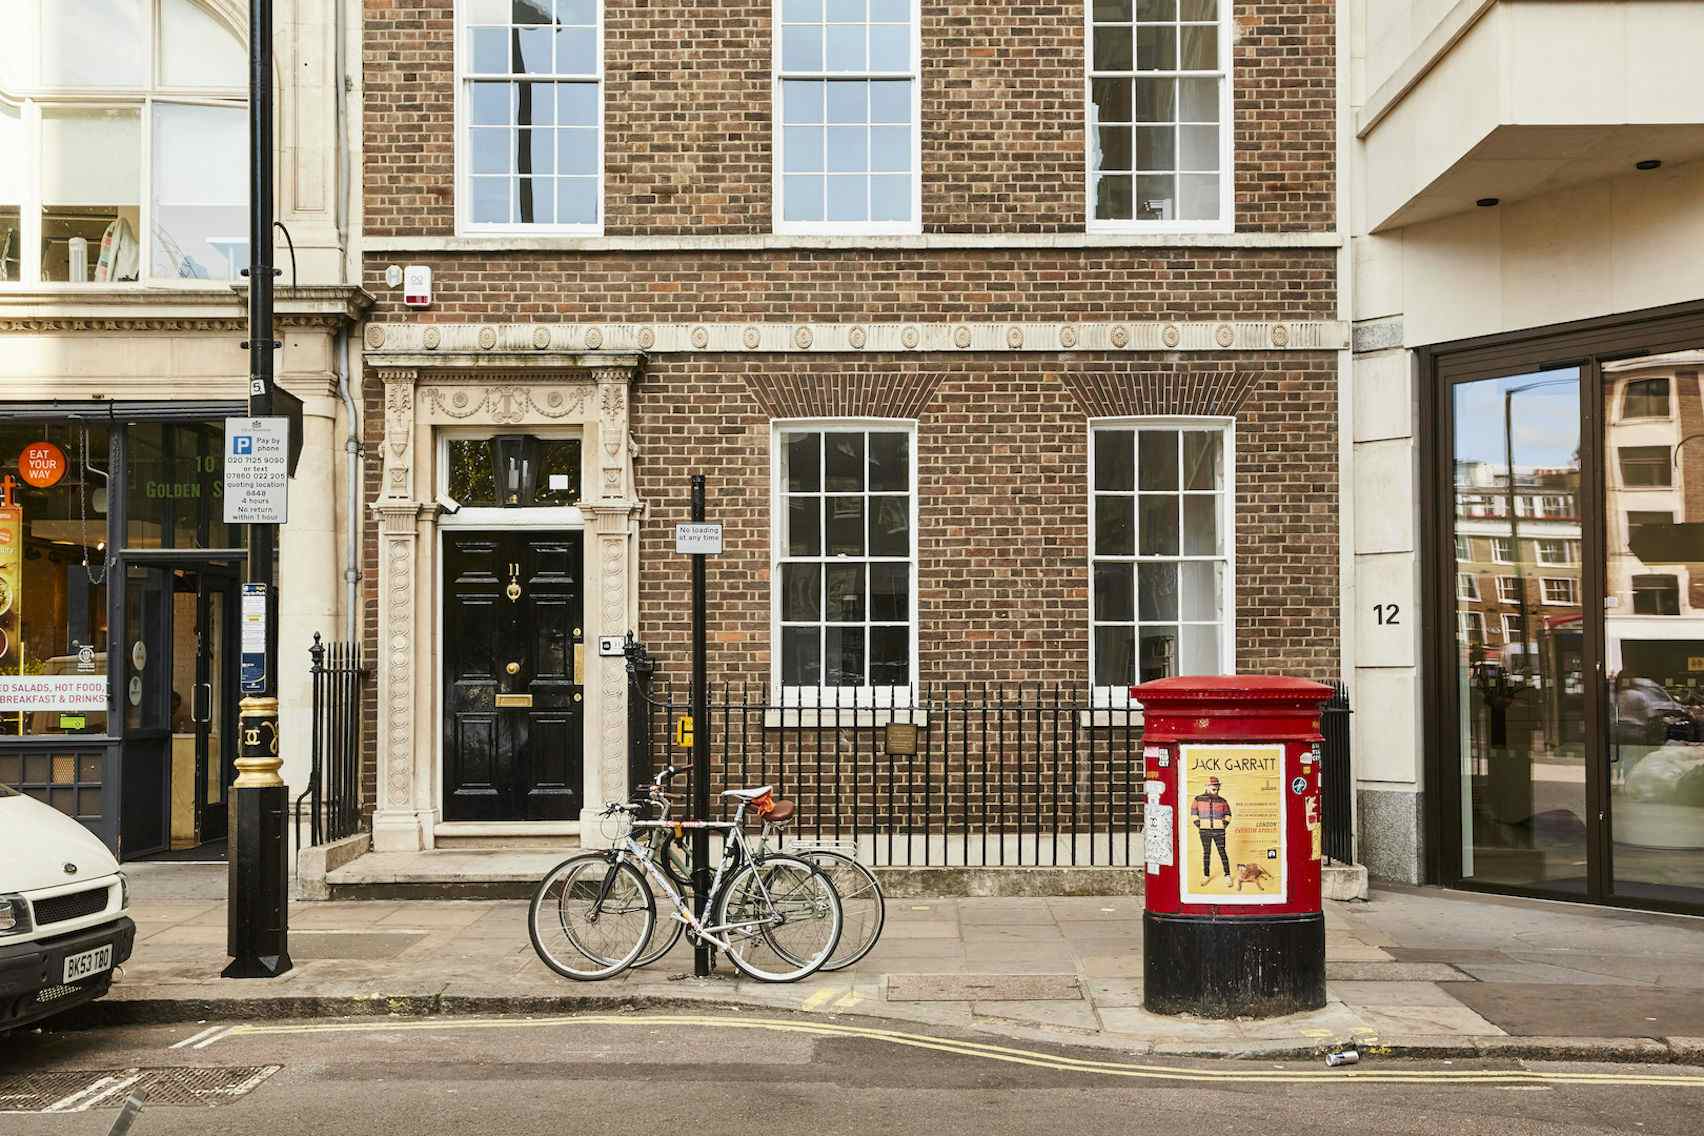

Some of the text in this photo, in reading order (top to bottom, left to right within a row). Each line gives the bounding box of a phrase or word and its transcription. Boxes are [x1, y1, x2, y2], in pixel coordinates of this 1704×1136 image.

[237, 437, 250, 453] P
[257, 437, 280, 445] Pay by
[28, 449, 49, 459] EAT
[257, 445, 280, 453] phone
[28, 459, 57, 469] YOUR
[195, 455, 216, 473] 10
[28, 469, 50, 479] WAY
[145, 480, 201, 498] GOLDEN
[692, 527, 719, 535] loading
[509, 563, 519, 576] 11
[1373, 604, 1400, 625] 12
[11, 683, 52, 693] SALADS,
[55, 683, 75, 692] HOT
[76, 683, 105, 693] FOOD,
[0, 694, 105, 704] BREAKFAST & DRINKS
[1192, 758, 1276, 771] JACK GARRATT
[68, 954, 92, 978] BK53
